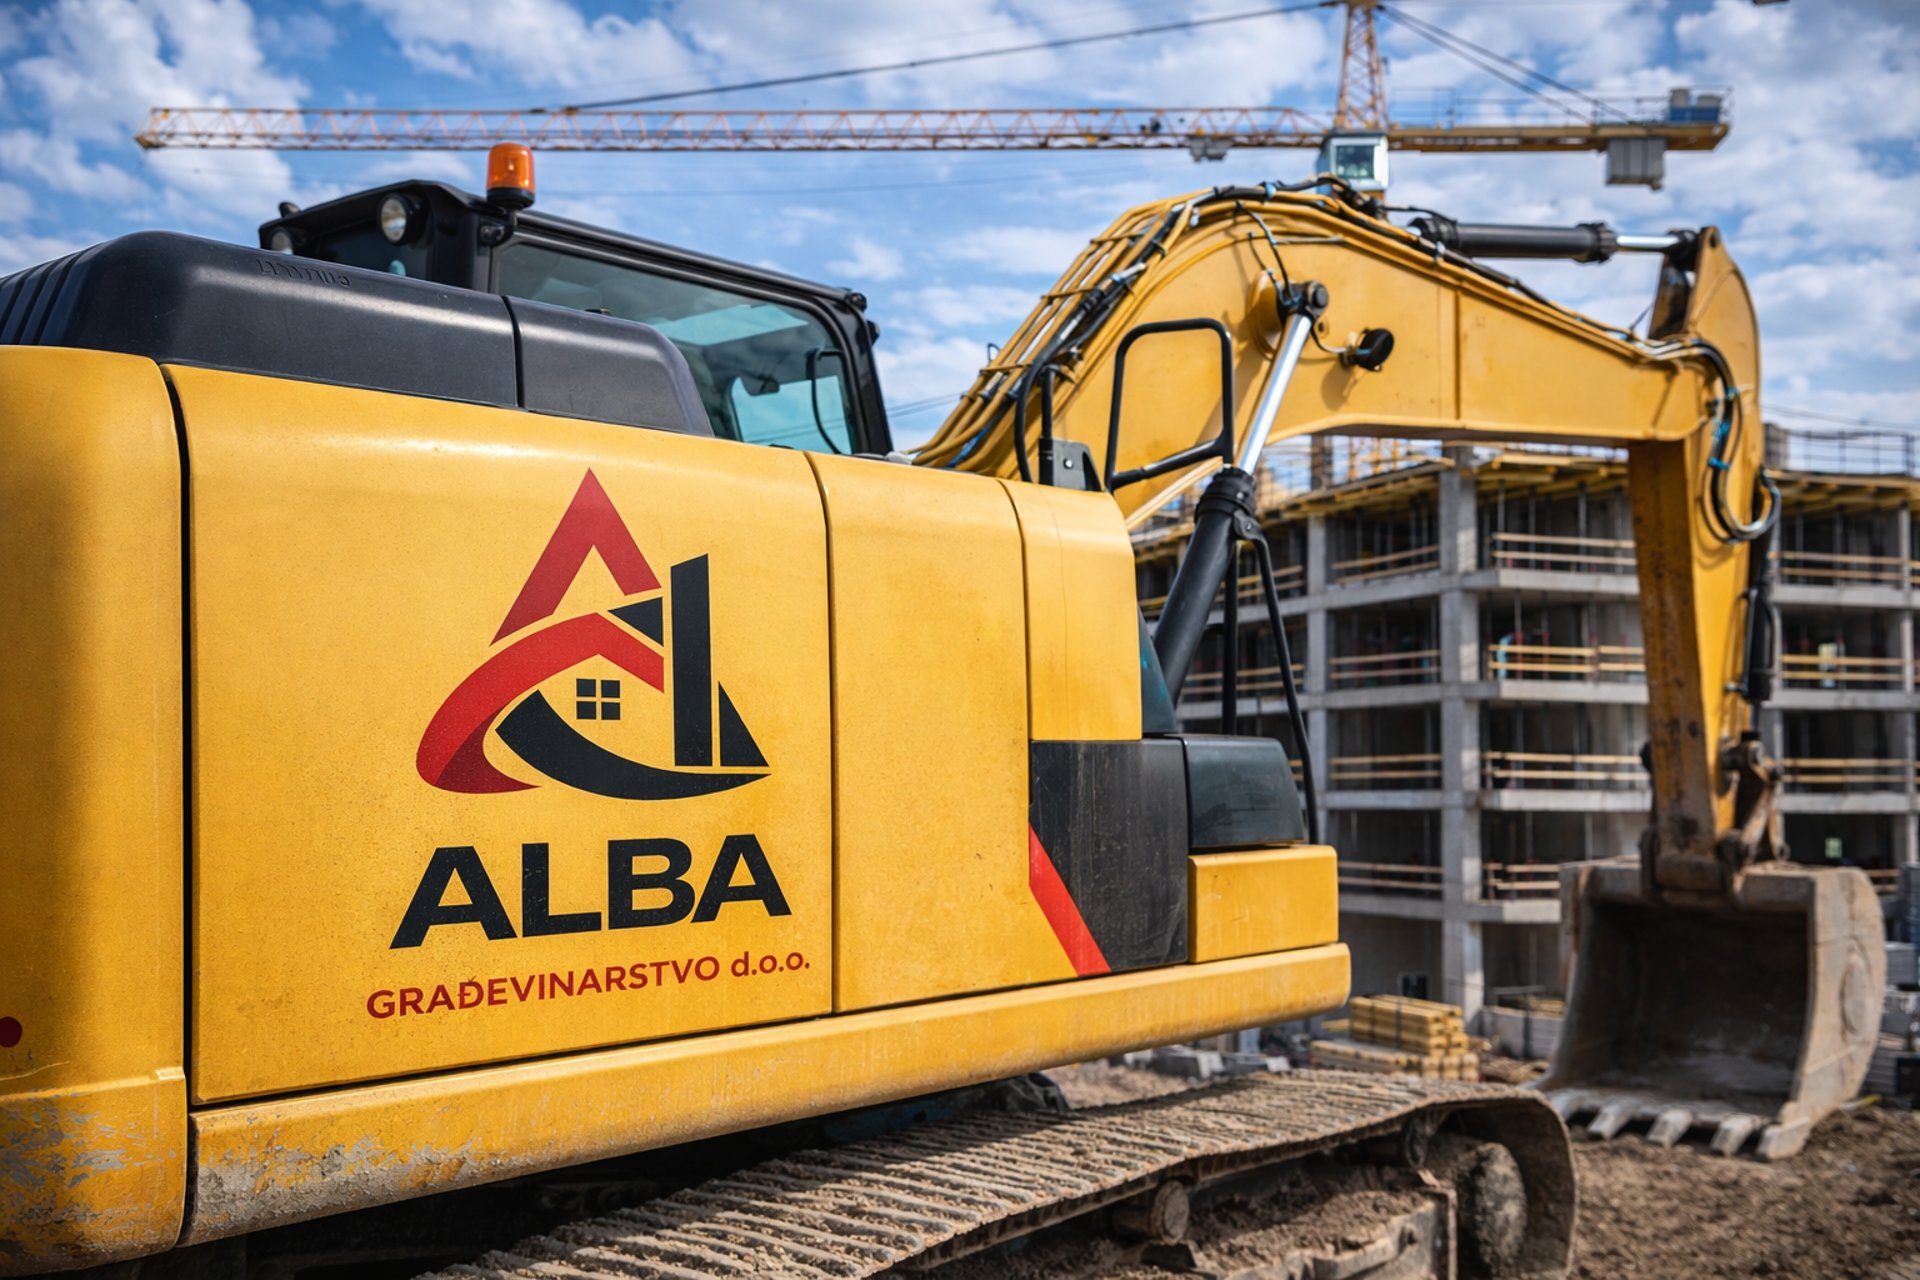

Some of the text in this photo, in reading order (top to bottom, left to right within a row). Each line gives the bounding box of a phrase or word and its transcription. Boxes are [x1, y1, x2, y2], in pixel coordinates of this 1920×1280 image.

[389, 833, 792, 950] ALBA
[366, 950, 811, 1019] GRAĐEVINARSTVO d.o.o.
